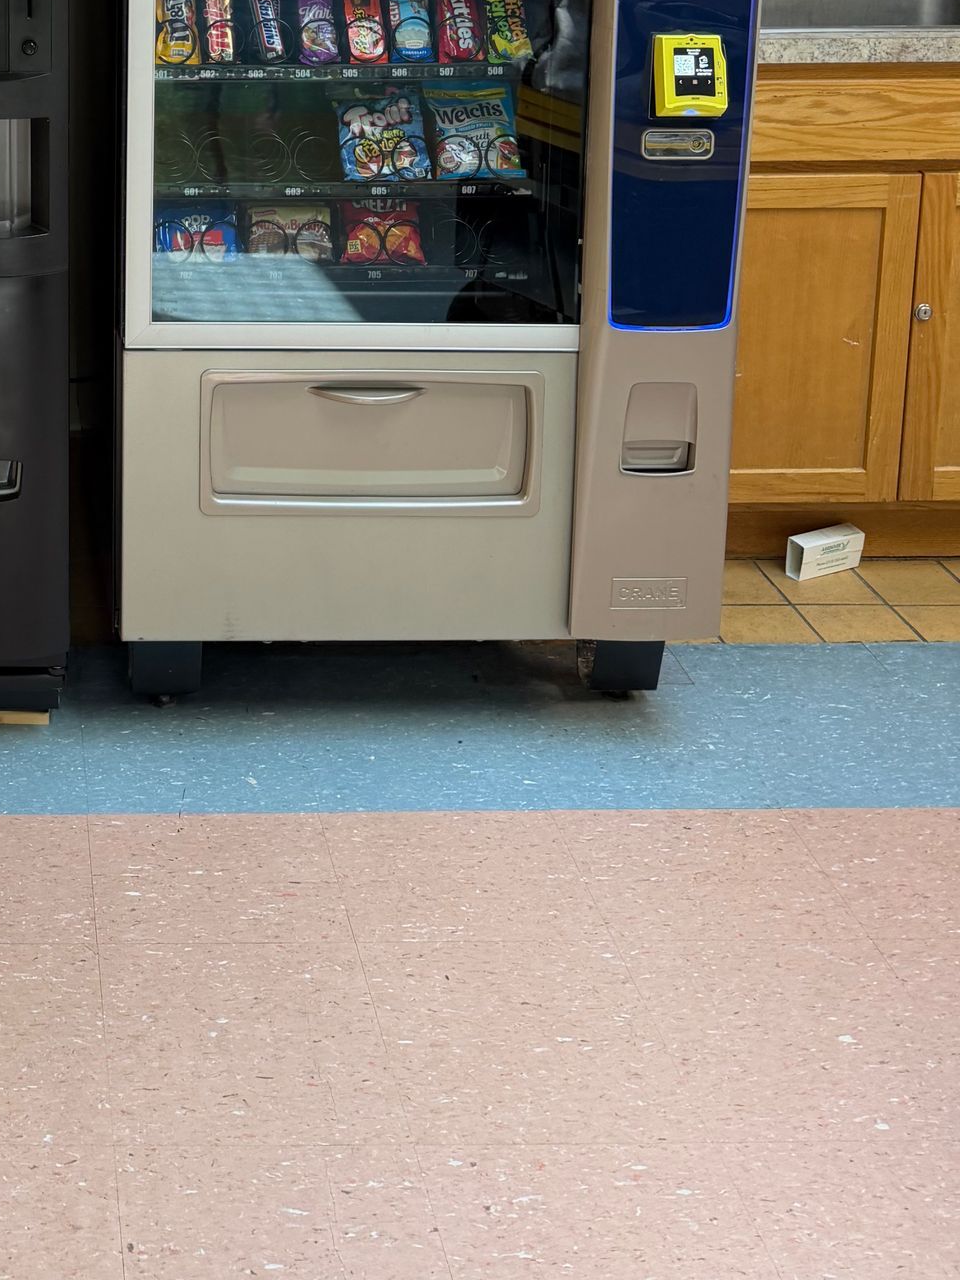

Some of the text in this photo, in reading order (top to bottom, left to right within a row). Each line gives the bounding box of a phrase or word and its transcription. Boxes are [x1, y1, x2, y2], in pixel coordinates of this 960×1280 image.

[201, 70, 215, 78] 502
[248, 70, 263, 78] 503
[295, 69, 310, 77] 504
[343, 69, 358, 77] 505
[392, 68, 407, 76] 506
[440, 67, 453, 76] 507
[488, 66, 503, 75] 508
[436, 103, 503, 126] Welch's
[368, 271, 382, 279] 705
[465, 270, 478, 278] 707
[617, 586, 680, 602] CRANE
